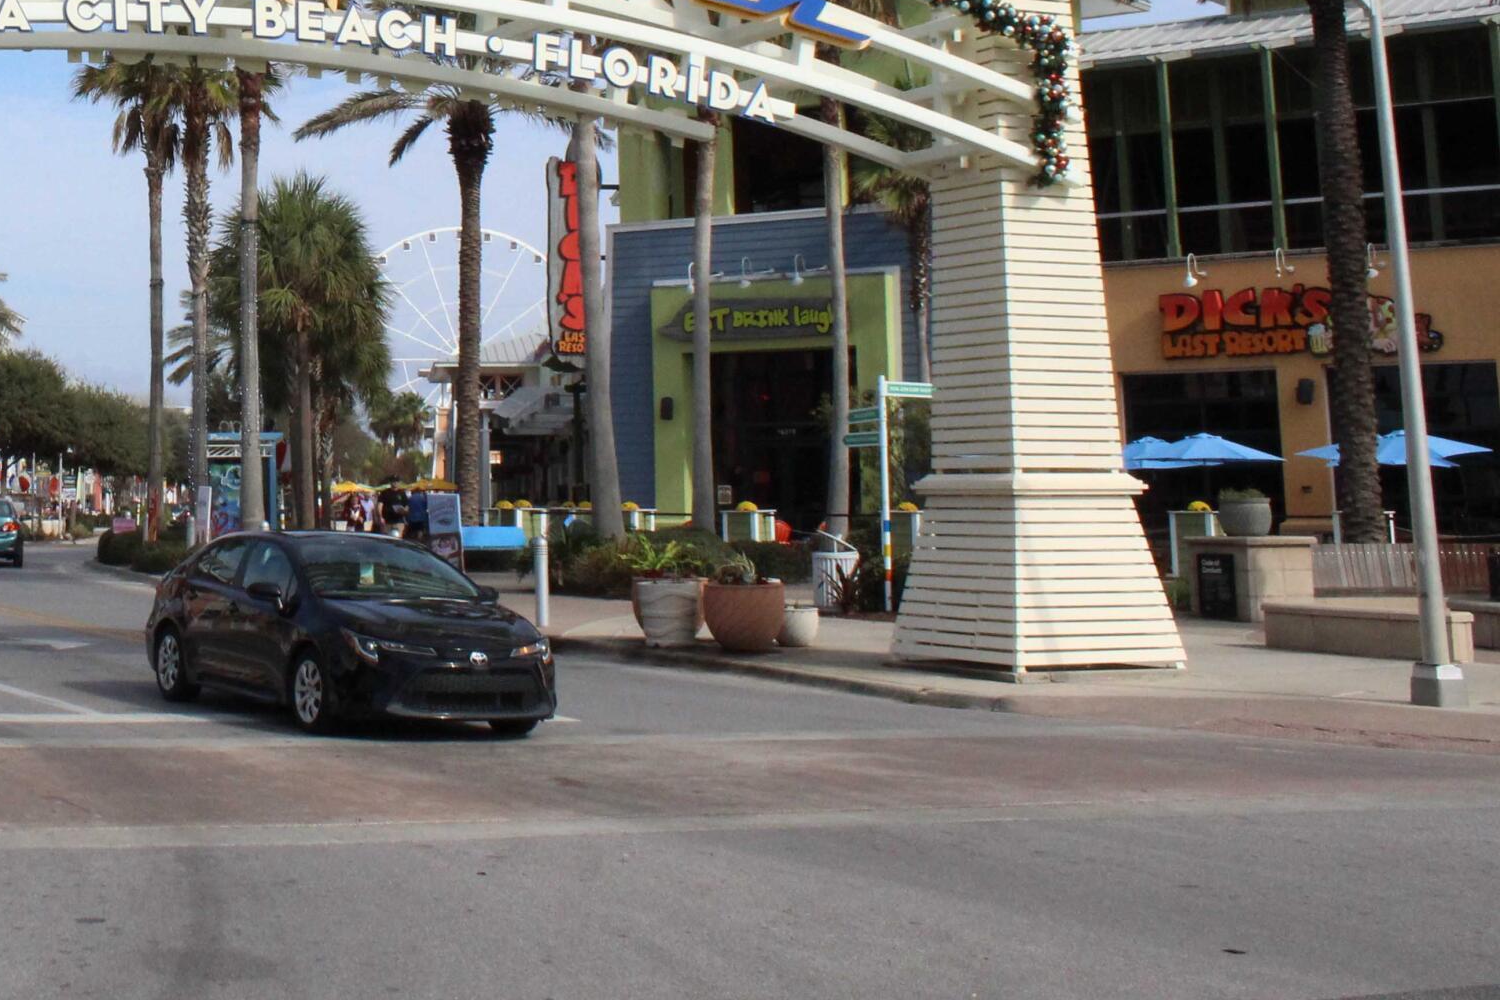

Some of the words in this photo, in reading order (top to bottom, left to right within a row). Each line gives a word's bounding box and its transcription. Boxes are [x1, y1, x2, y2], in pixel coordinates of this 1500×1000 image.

[533, 31, 778, 124] FLORIDA
[733, 309, 790, 328] DRINK
[1159, 284, 1332, 332] DICK'S
[1164, 332, 1219, 358] LAST
[1225, 329, 1306, 357] RESORT
